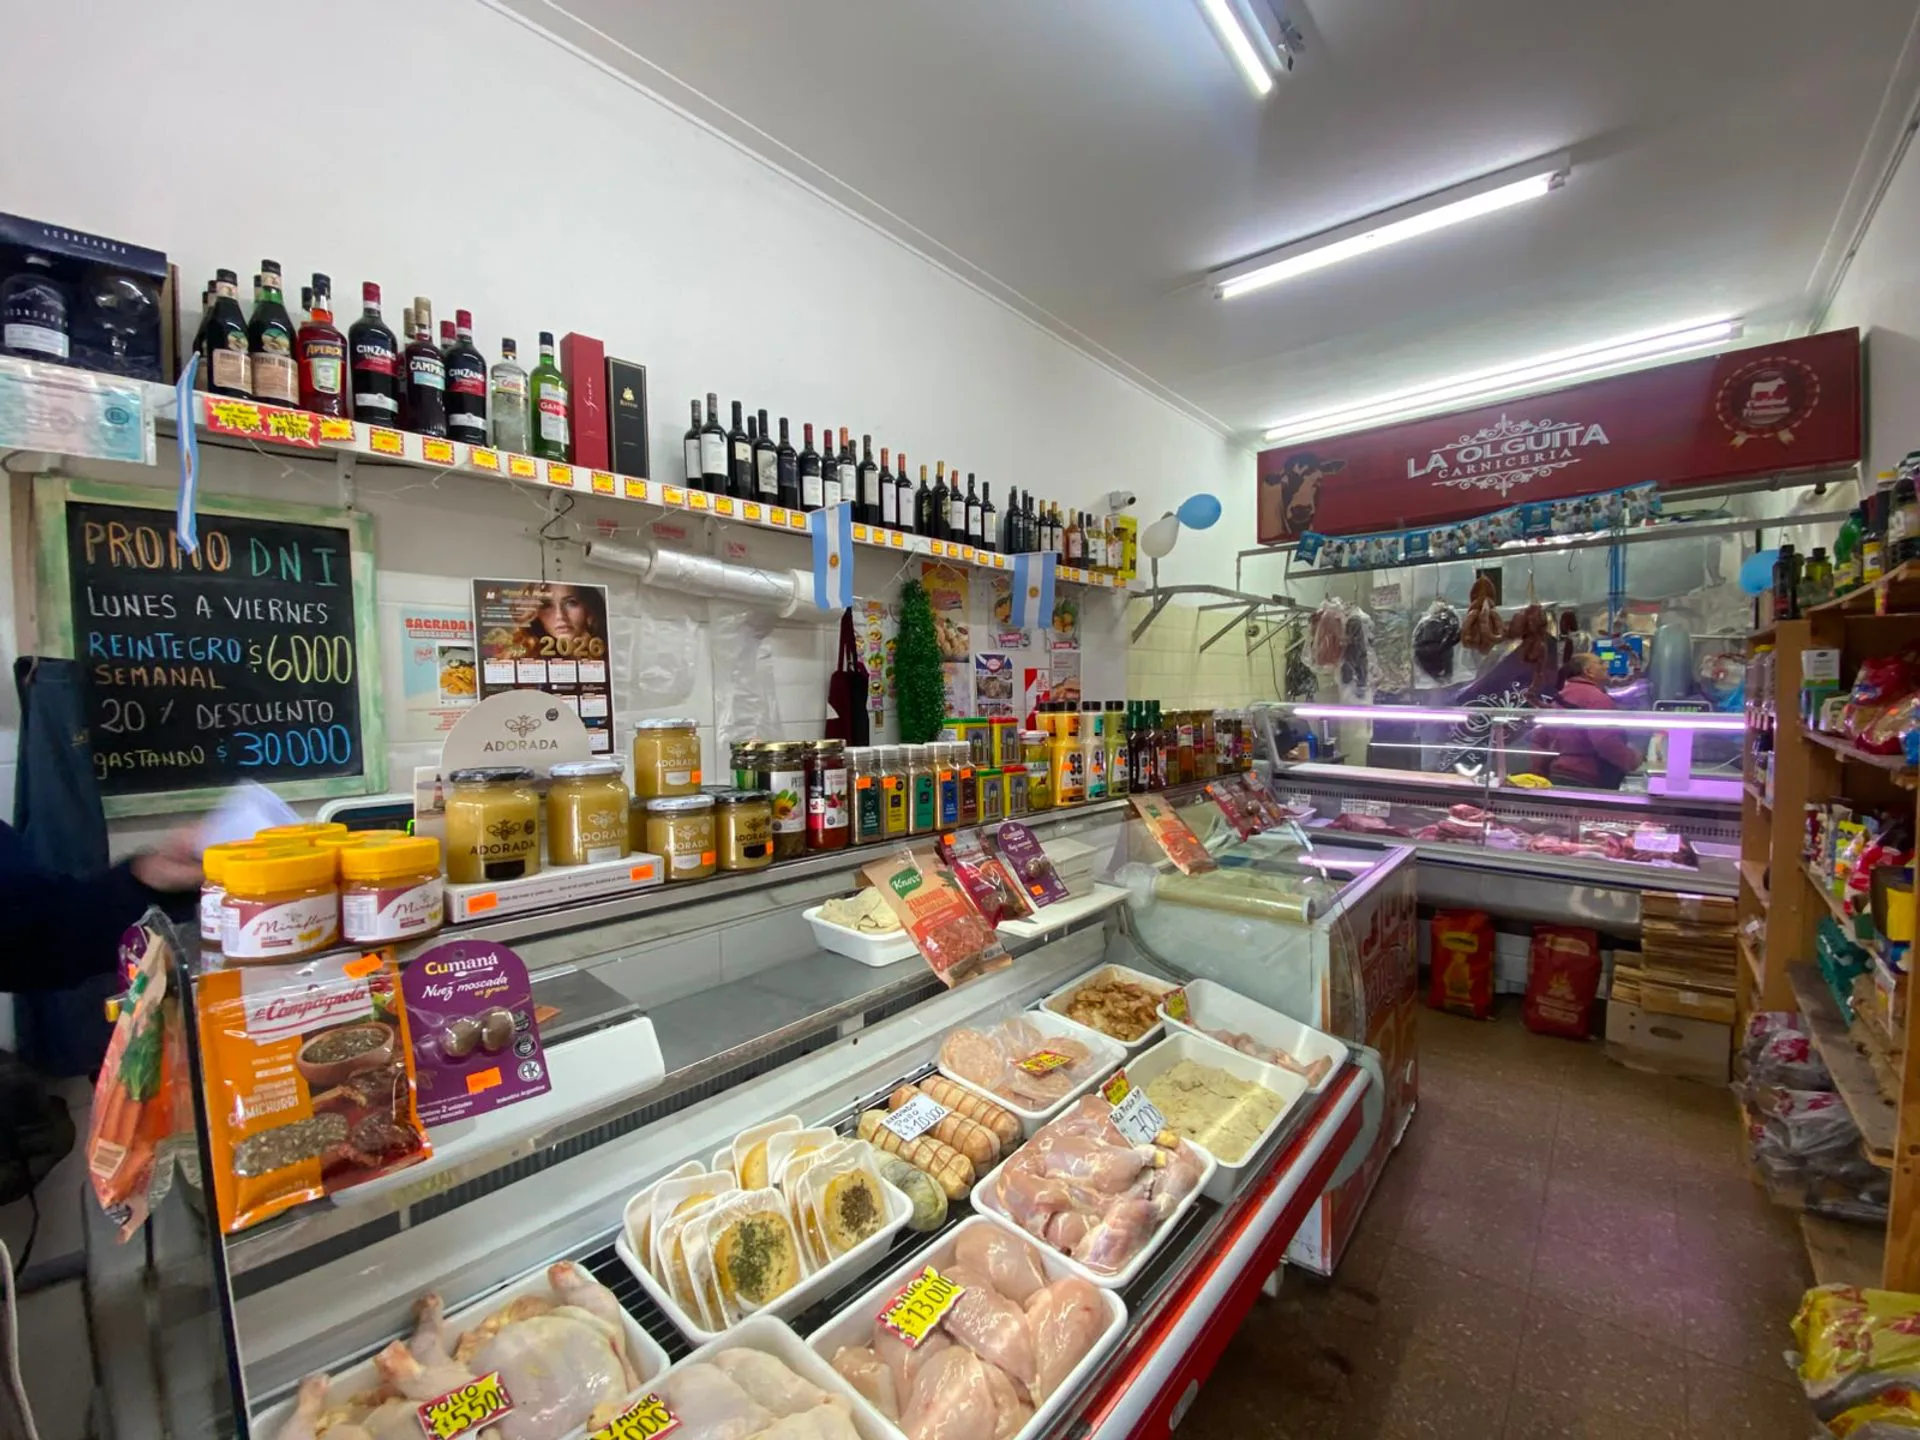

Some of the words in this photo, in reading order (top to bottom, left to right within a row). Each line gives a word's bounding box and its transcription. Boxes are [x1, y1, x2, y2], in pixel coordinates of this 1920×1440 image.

[1407, 452, 1448, 479] LA
[1456, 424, 1610, 463] OLGUITA
[1438, 448, 1573, 479] CARNICERIA
[87, 586, 177, 619] LUNES
[195, 595, 213, 620] A
[223, 596, 330, 625] VIERNES
[88, 631, 241, 664] REINTEGRO
[539, 636, 606, 658] 2026
[95, 664, 227, 690] SEMANAL
[100, 698, 146, 733] 20
[196, 699, 334, 730] DESCUENTO
[483, 738, 559, 753] ADORADA
[470, 839, 536, 856] ADORADA
[891, 873, 921, 891] Knorr
[425, 952, 499, 976] Cumaná
[457, 970, 509, 992] moscada
[266, 987, 366, 1021] Campagnola
[878, 1273, 932, 1323] PECHUGA
